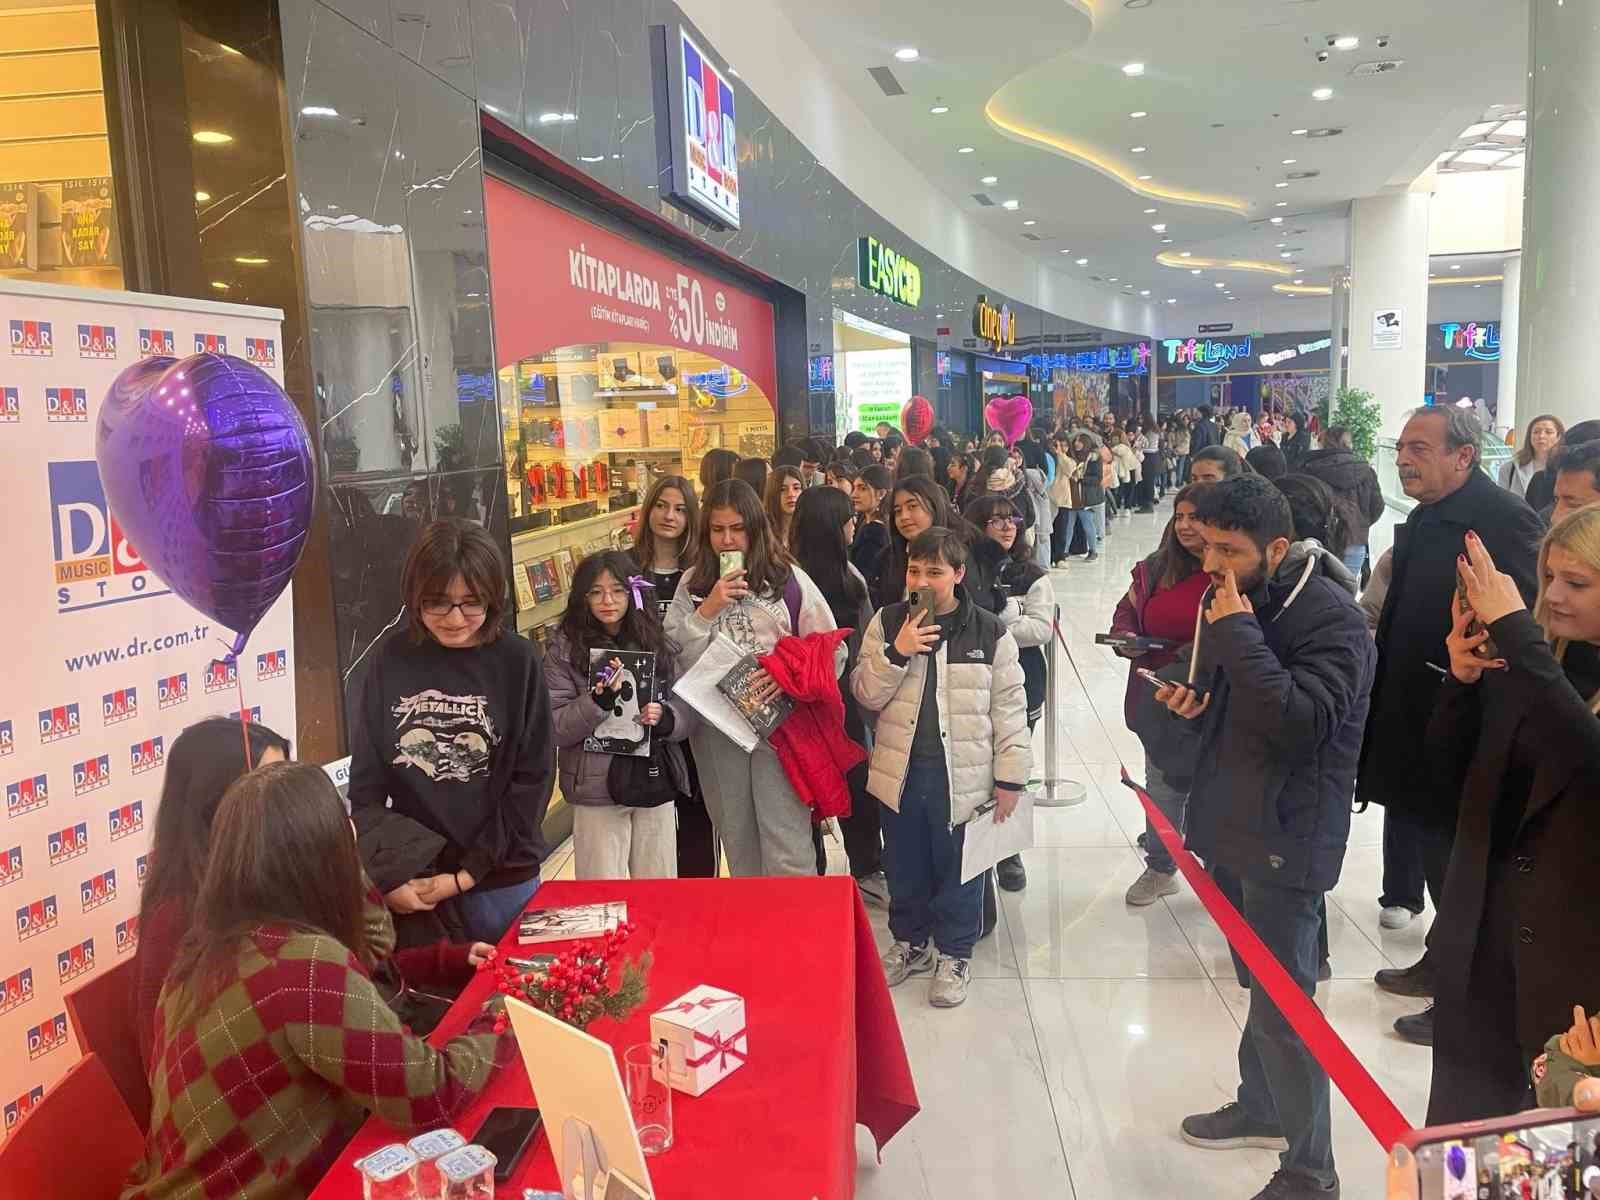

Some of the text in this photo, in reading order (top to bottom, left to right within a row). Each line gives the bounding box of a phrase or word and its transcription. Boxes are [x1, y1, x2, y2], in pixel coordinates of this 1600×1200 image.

[688, 77, 738, 172] D&R
[568, 243, 662, 311] KİTAPLARDA
[705, 311, 738, 352] İNDİRİM
[60, 561, 108, 580] MUSIC
[65, 624, 209, 672] www.dr.com.tr
